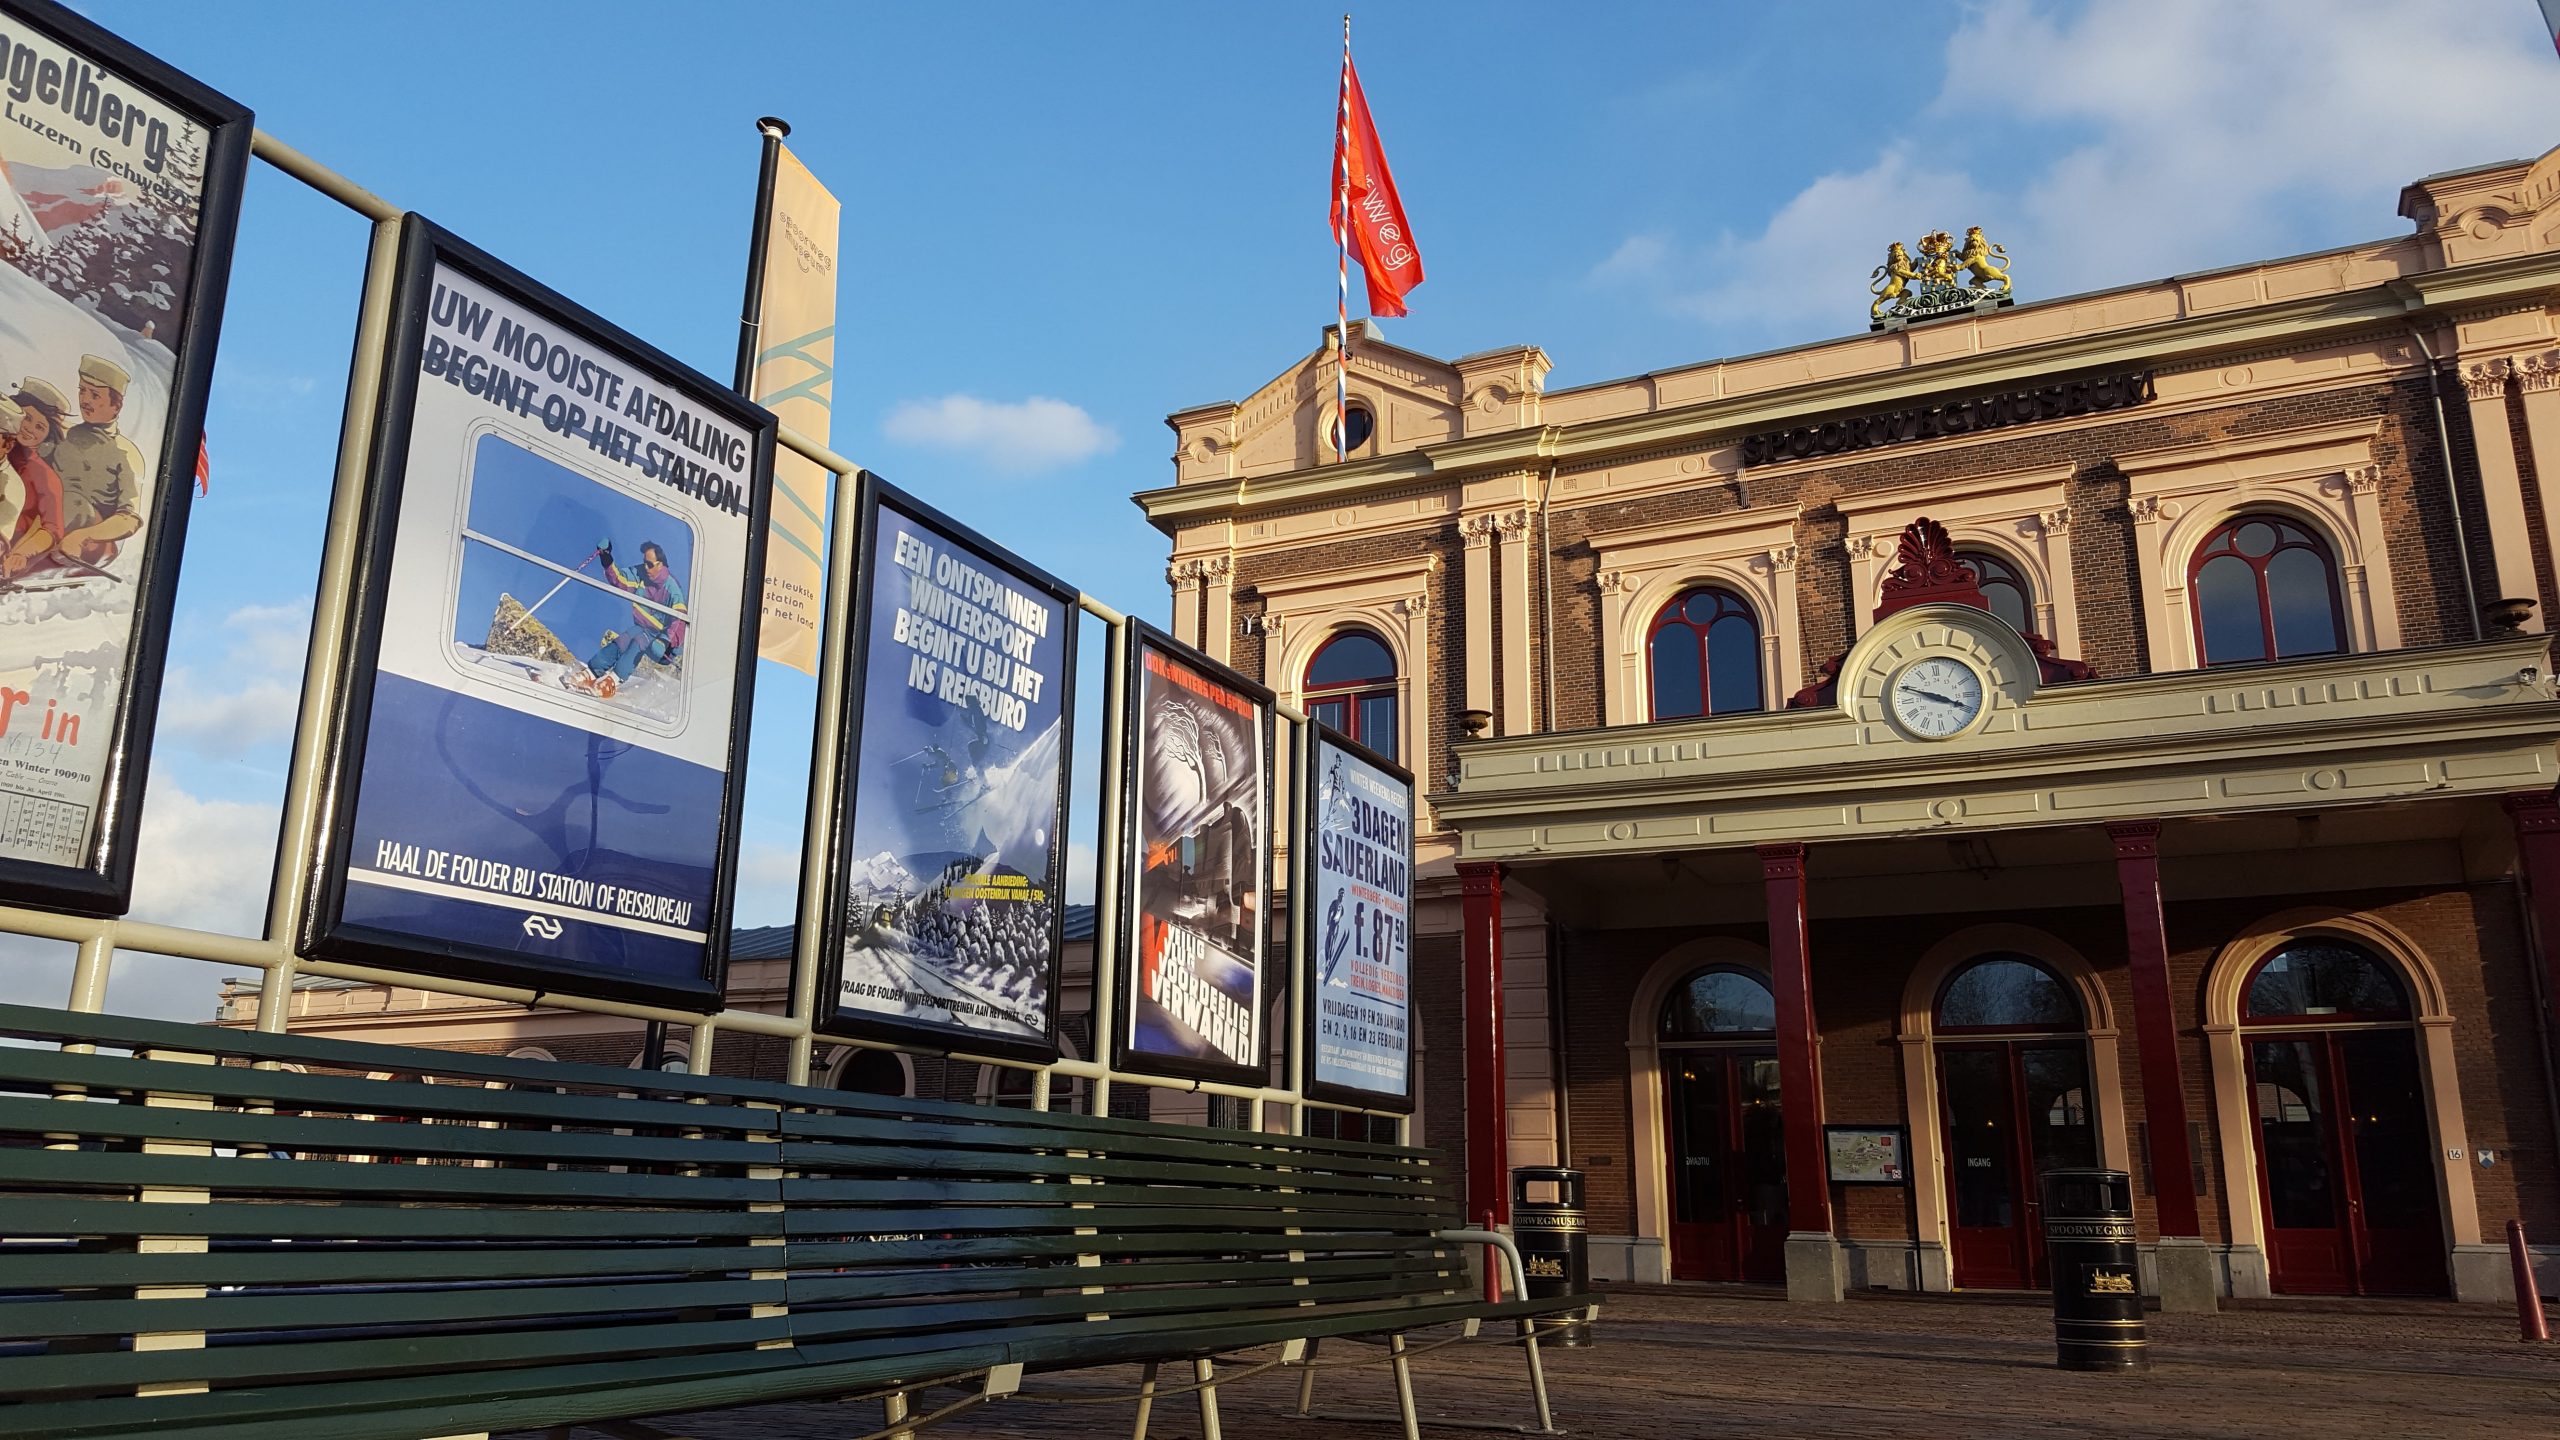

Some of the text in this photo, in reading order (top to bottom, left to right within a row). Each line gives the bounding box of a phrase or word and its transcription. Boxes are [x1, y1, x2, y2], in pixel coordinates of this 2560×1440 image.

[5, 101, 82, 154] Luzern
[780, 211, 831, 271] spoorweg
[785, 229, 826, 277] museum
[430, 283, 746, 473] UW MOOISTE AFDALING
[423, 335, 742, 517] BEGINT OP HET STATION
[1743, 369, 2159, 466] SPOORWEGMUSEUM
[764, 577, 814, 600] et leukste
[766, 591, 804, 610] station
[894, 530, 1049, 638] EEN ONTSPANNEN
[775, 608, 793, 620] het
[797, 614, 814, 629] land
[911, 575, 1036, 665] WINTERSPORT
[893, 607, 1044, 704] BEGINT U BIJ HET
[1145, 652, 1166, 677] OOK
[1171, 664, 1209, 698] WINTERS
[908, 653, 1027, 732] NS REISBURO
[41, 699, 81, 746] in
[15, 759, 50, 774] Winter
[54, 767, 91, 783] 1909/10
[1351, 796, 1406, 857] 3 DAGEN
[376, 839, 692, 927] HAAL DE FOLDER BIJ STATION OF REISBUREAU
[1321, 829, 1405, 898] SAUERLAND
[975, 887, 1010, 900] OOSTENRIJK
[1164, 936, 1196, 972] VLUG
[1167, 923, 1205, 959] VEILIG
[1350, 959, 1378, 978] VOLLEDIG
[840, 980, 865, 996] VRAAG
[866, 985, 877, 997] DE
[877, 986, 904, 1002] FOLDER
[904, 990, 975, 1015] WINTERSPORTTREINEN
[975, 1004, 989, 1018] AAN
[989, 1005, 1001, 1019] HET
[1158, 951, 1249, 1035] VOORDEELIG
[1322, 998, 1358, 1020] VRIJDAGEN
[1360, 1007, 1367, 1021] 19
[1367, 1009, 1375, 1025] EN
[1384, 1013, 1405, 1033] JANUARI
[1151, 969, 1249, 1066] VERWARMD
[1322, 1019, 1332, 1035] EN
[1334, 1022, 1341, 1038] 2,
[1350, 1026, 1357, 1040] 16
[1358, 1027, 1367, 1042] EN
[1368, 1030, 1376, 1044] 23
[1377, 1031, 1405, 1051] FEBRUARI
[1967, 1157, 1991, 1167] INGANG
[2450, 1150, 2461, 1159] 16
